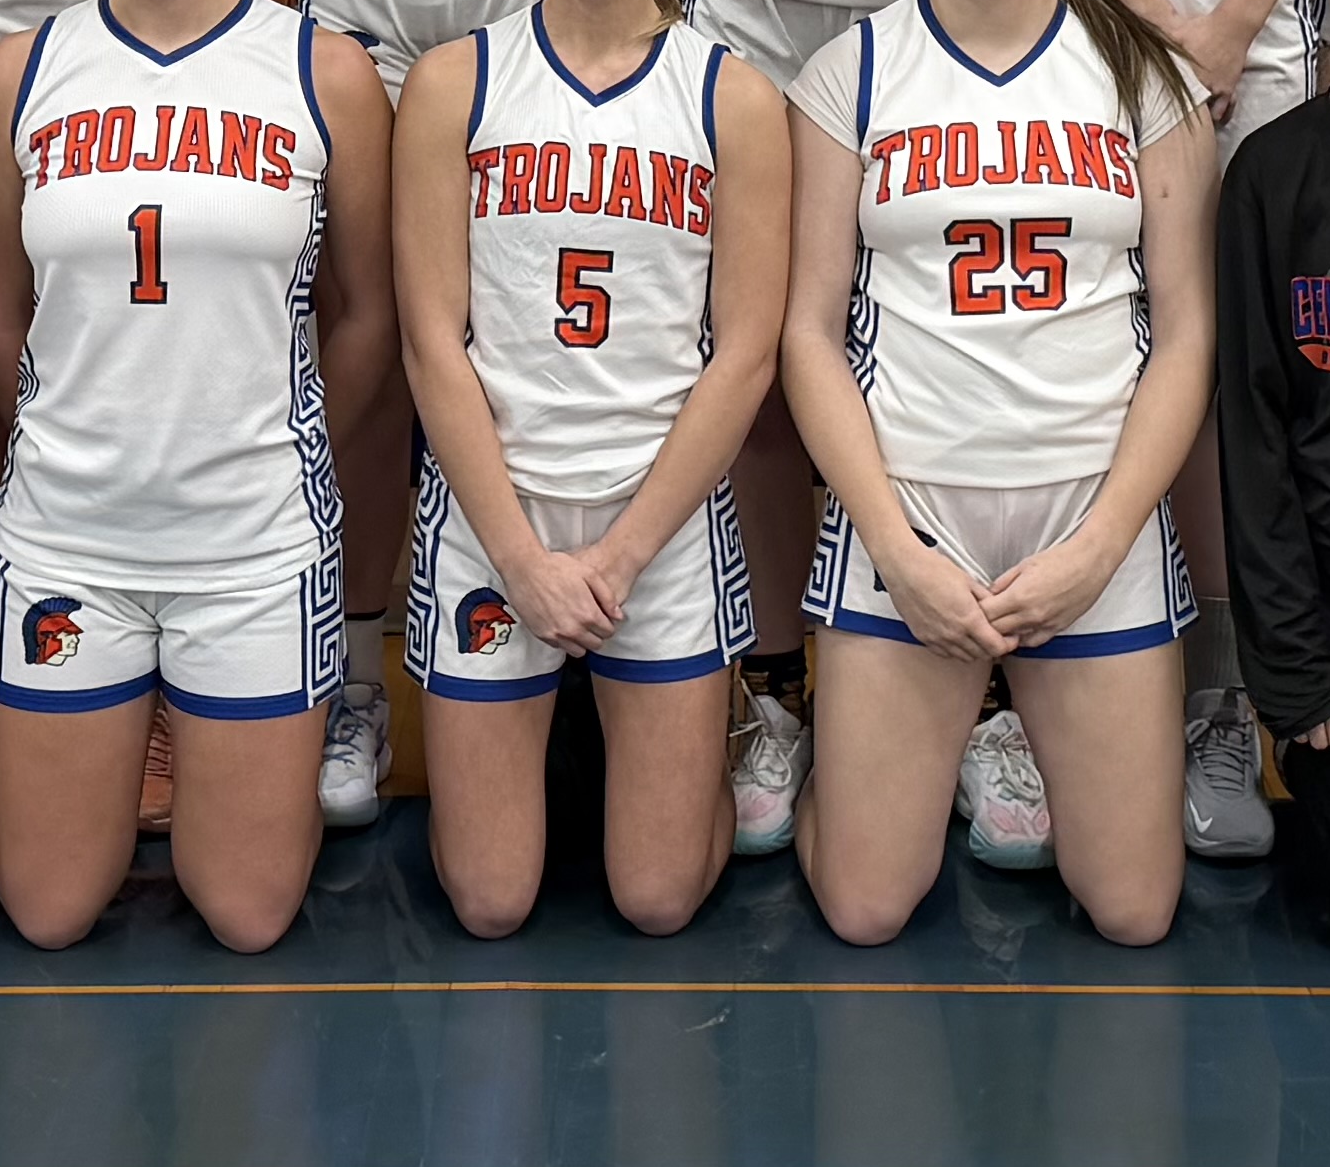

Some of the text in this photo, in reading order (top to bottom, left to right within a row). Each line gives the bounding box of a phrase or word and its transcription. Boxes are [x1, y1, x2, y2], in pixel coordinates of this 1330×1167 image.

[29, 105, 296, 191] TROJANS
[469, 142, 714, 236] TROJANS
[871, 120, 1135, 205] TROJANS
[127, 204, 168, 304] 1
[554, 247, 615, 348] 5
[943, 217, 1072, 316] 25
